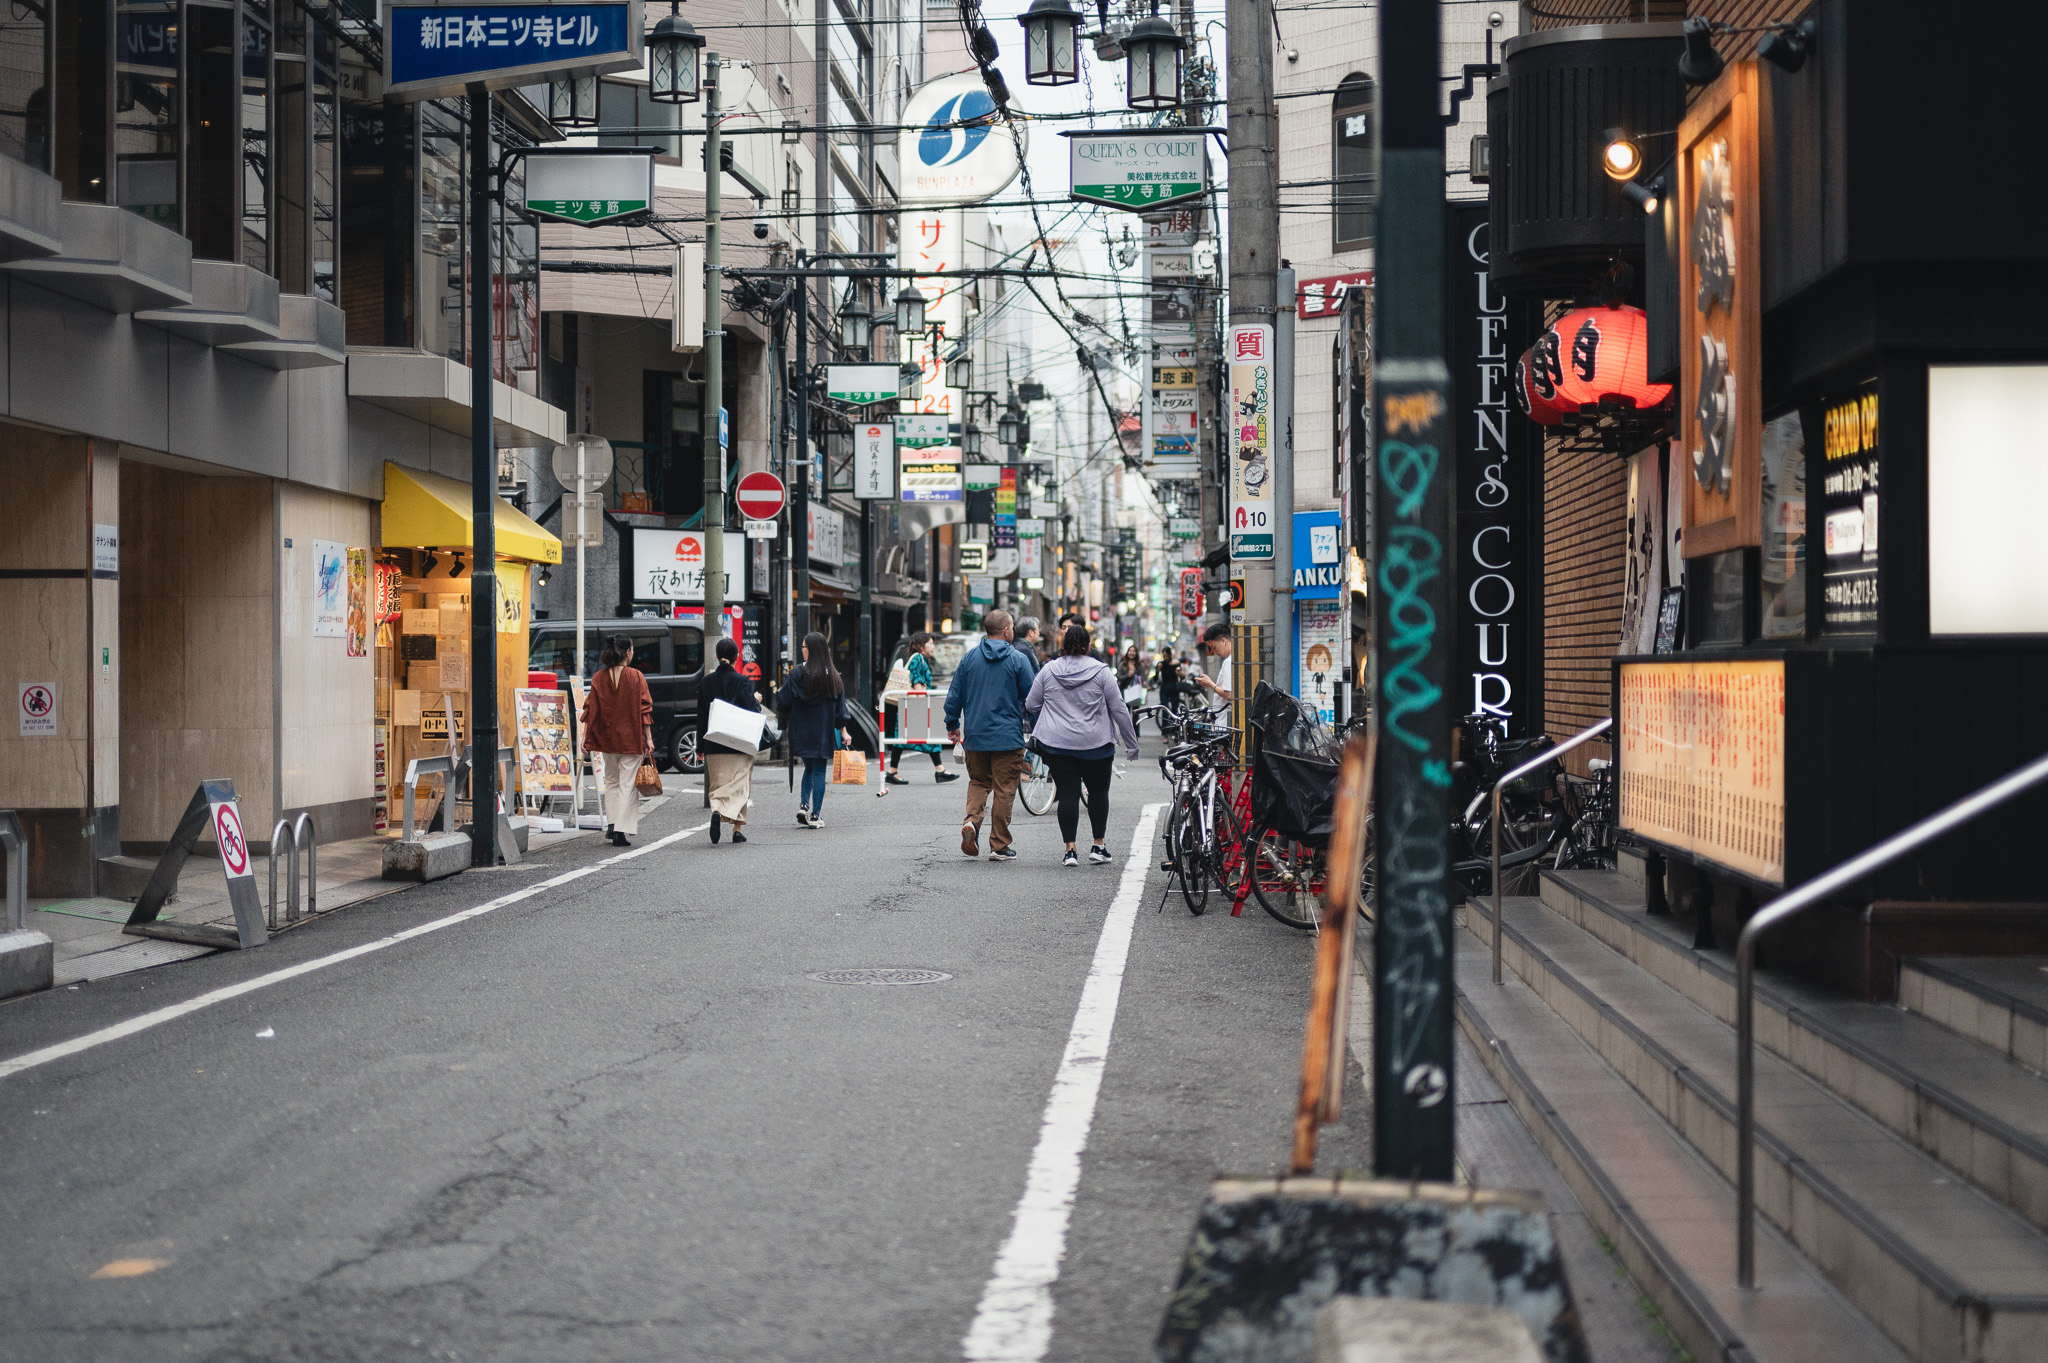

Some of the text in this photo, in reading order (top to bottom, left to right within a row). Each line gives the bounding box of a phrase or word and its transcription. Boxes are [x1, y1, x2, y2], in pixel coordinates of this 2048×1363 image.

[421, 15, 598, 48] 新日本三ツ寺ビル
[1078, 141, 1198, 162] QUEEN'S COURT
[1126, 171, 1198, 181] 美松観光株式会社
[1103, 184, 1173, 198] 三ツ寺筋
[554, 201, 619, 214] 三ツ寺筋
[1236, 332, 1262, 357] 質
[1163, 372, 1194, 385] 恋瀬
[1255, 366, 1269, 413] あきんど
[1250, 512, 1267, 527] 10
[1313, 533, 1334, 543] ファン
[1317, 545, 1331, 555] クラ
[1469, 526, 1515, 738] COUR
